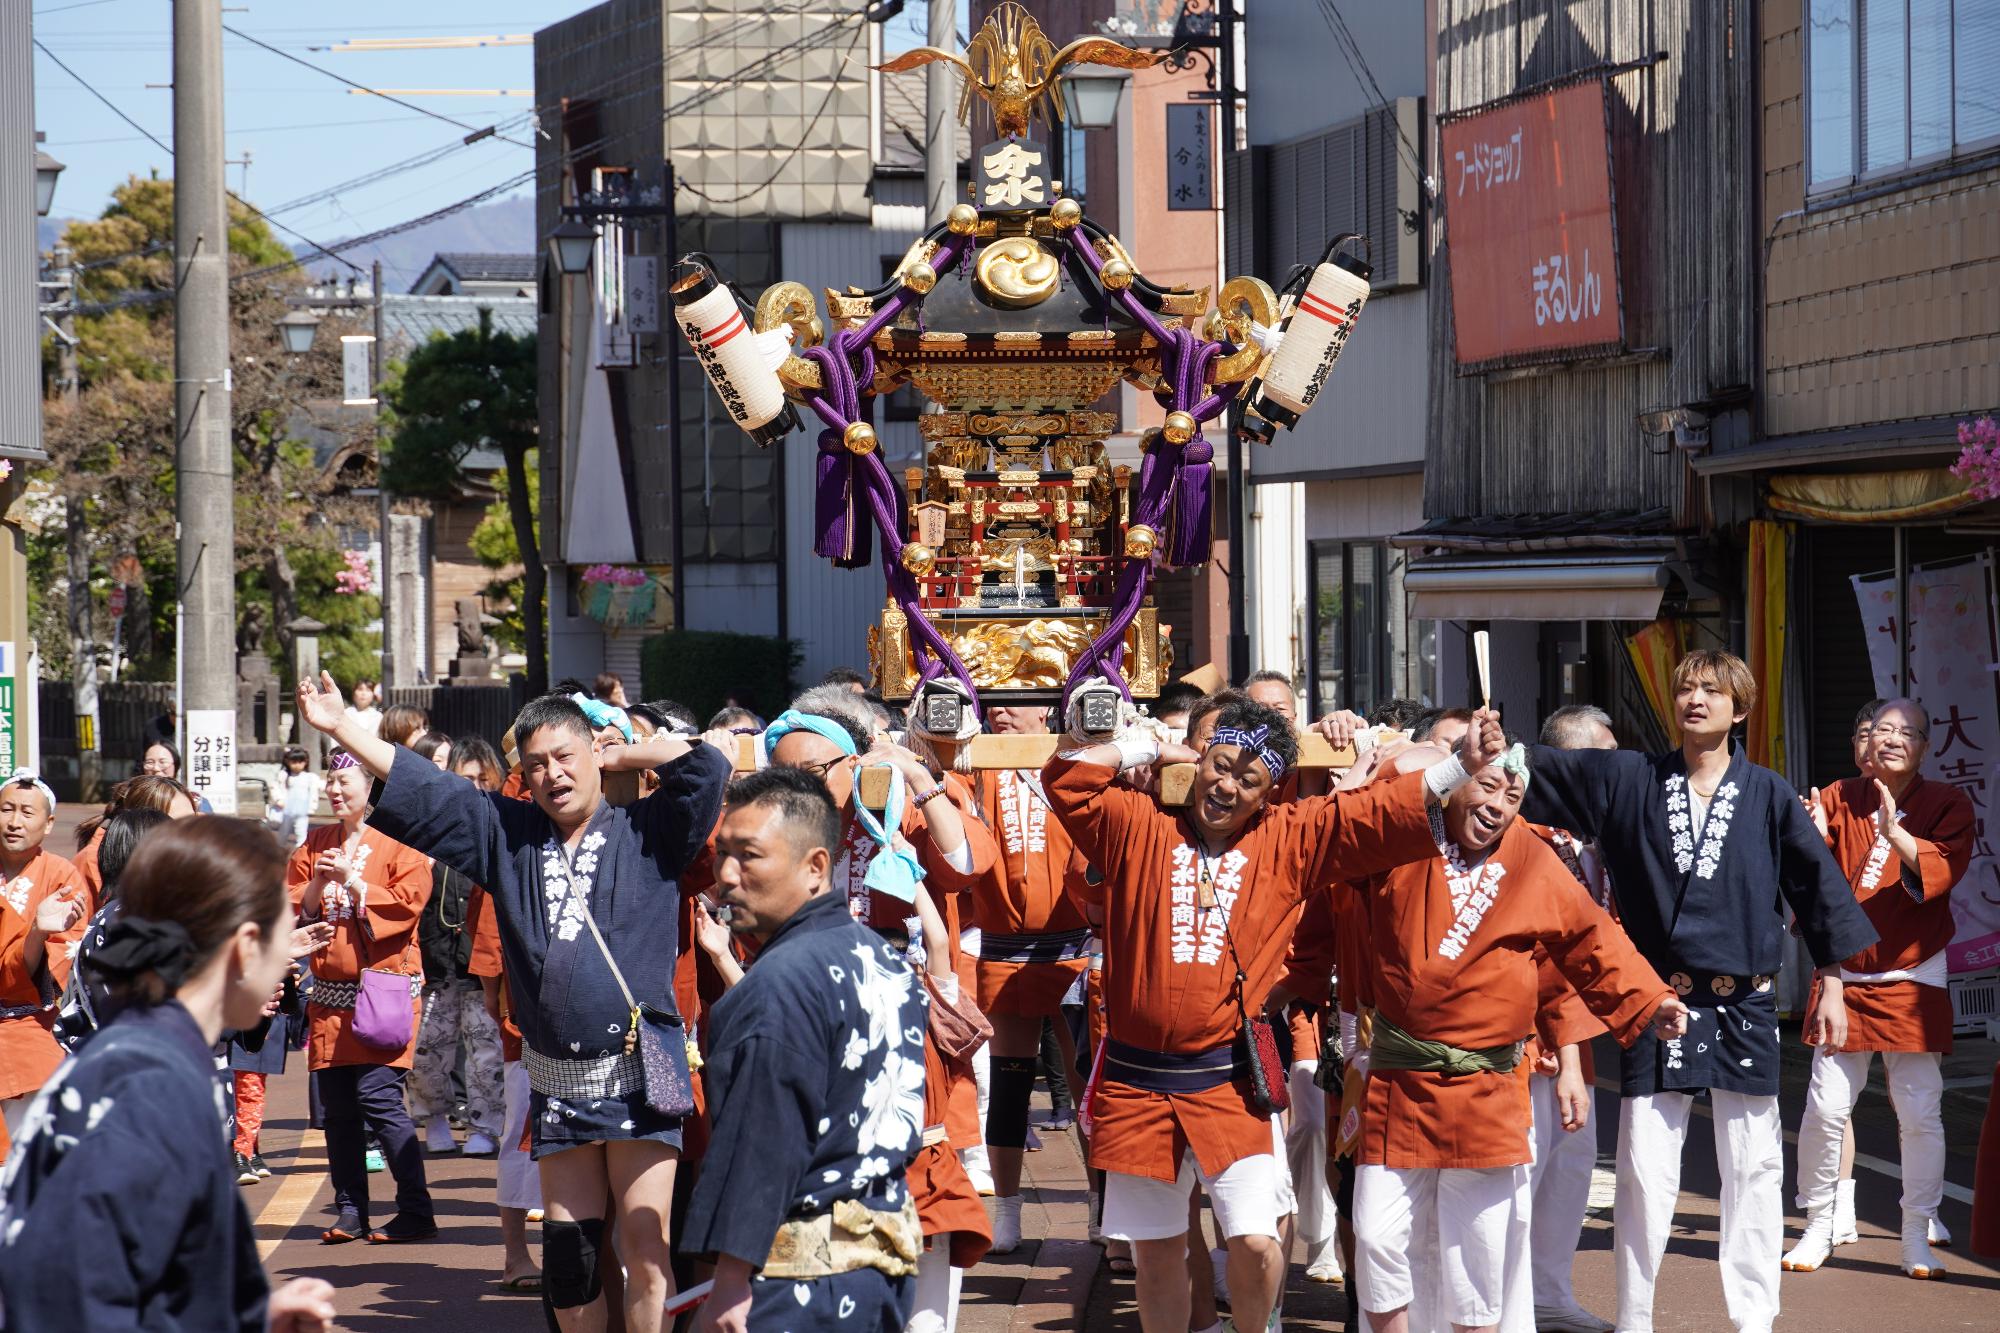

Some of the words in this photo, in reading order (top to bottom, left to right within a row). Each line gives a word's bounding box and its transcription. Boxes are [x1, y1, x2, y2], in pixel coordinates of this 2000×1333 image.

[984, 143, 1044, 206] 分水
[1174, 147, 1193, 202] 分水
[1455, 125, 1523, 197] フードショップ
[1532, 248, 1601, 326] まるしん
[194, 736, 211, 791] 分譲中
[216, 736, 231, 773] 好評
[997, 769, 1023, 854] 分水町商工会
[1171, 843, 1197, 963] 分水町商工会
[1198, 849, 1249, 966] 分水町商工会
[1438, 862, 1506, 960] 分水町商工会
